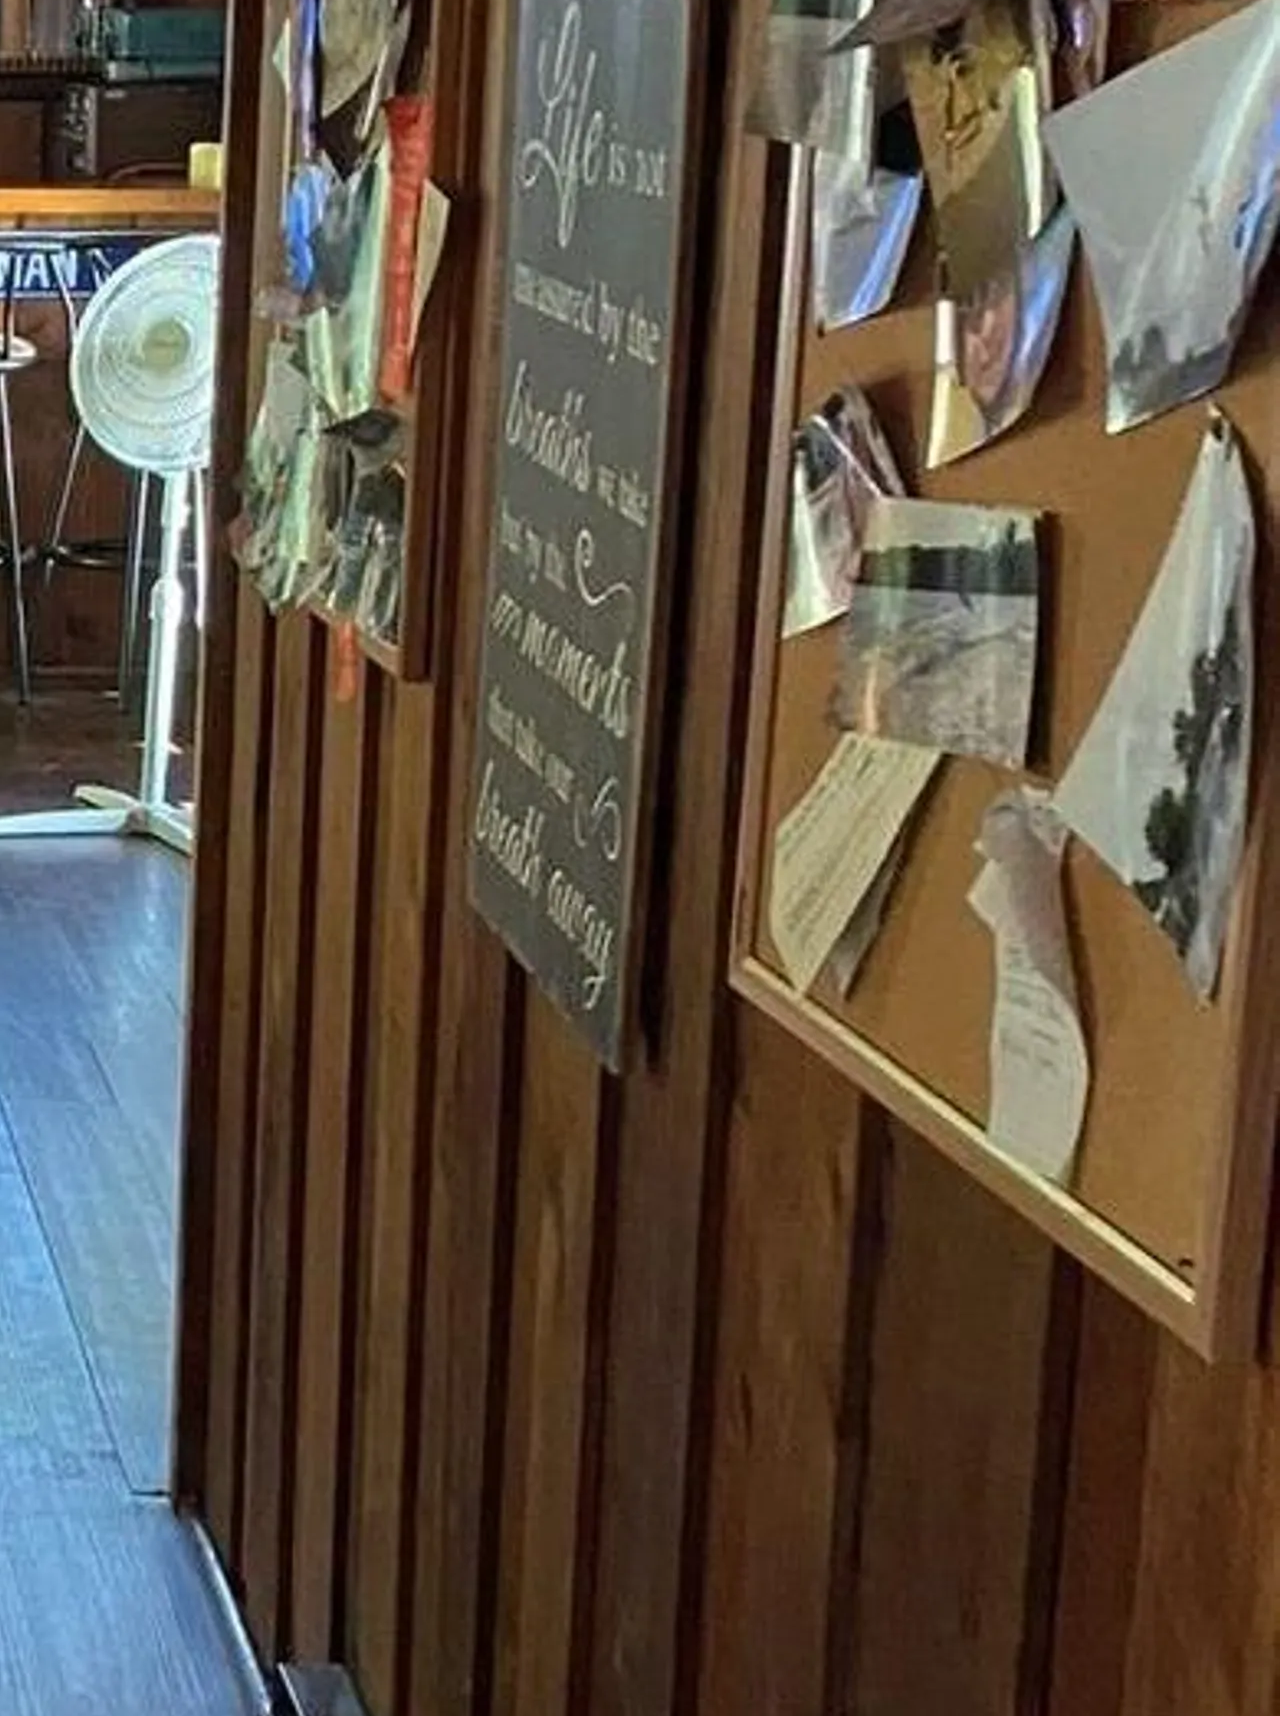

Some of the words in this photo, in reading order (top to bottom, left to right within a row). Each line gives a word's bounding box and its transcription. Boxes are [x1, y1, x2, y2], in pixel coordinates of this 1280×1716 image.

[520, 0, 605, 250] Life
[607, 121, 627, 185] is
[597, 281, 622, 364] by
[626, 293, 661, 366] the
[474, 760, 545, 899] breath
[547, 868, 614, 1012] away
